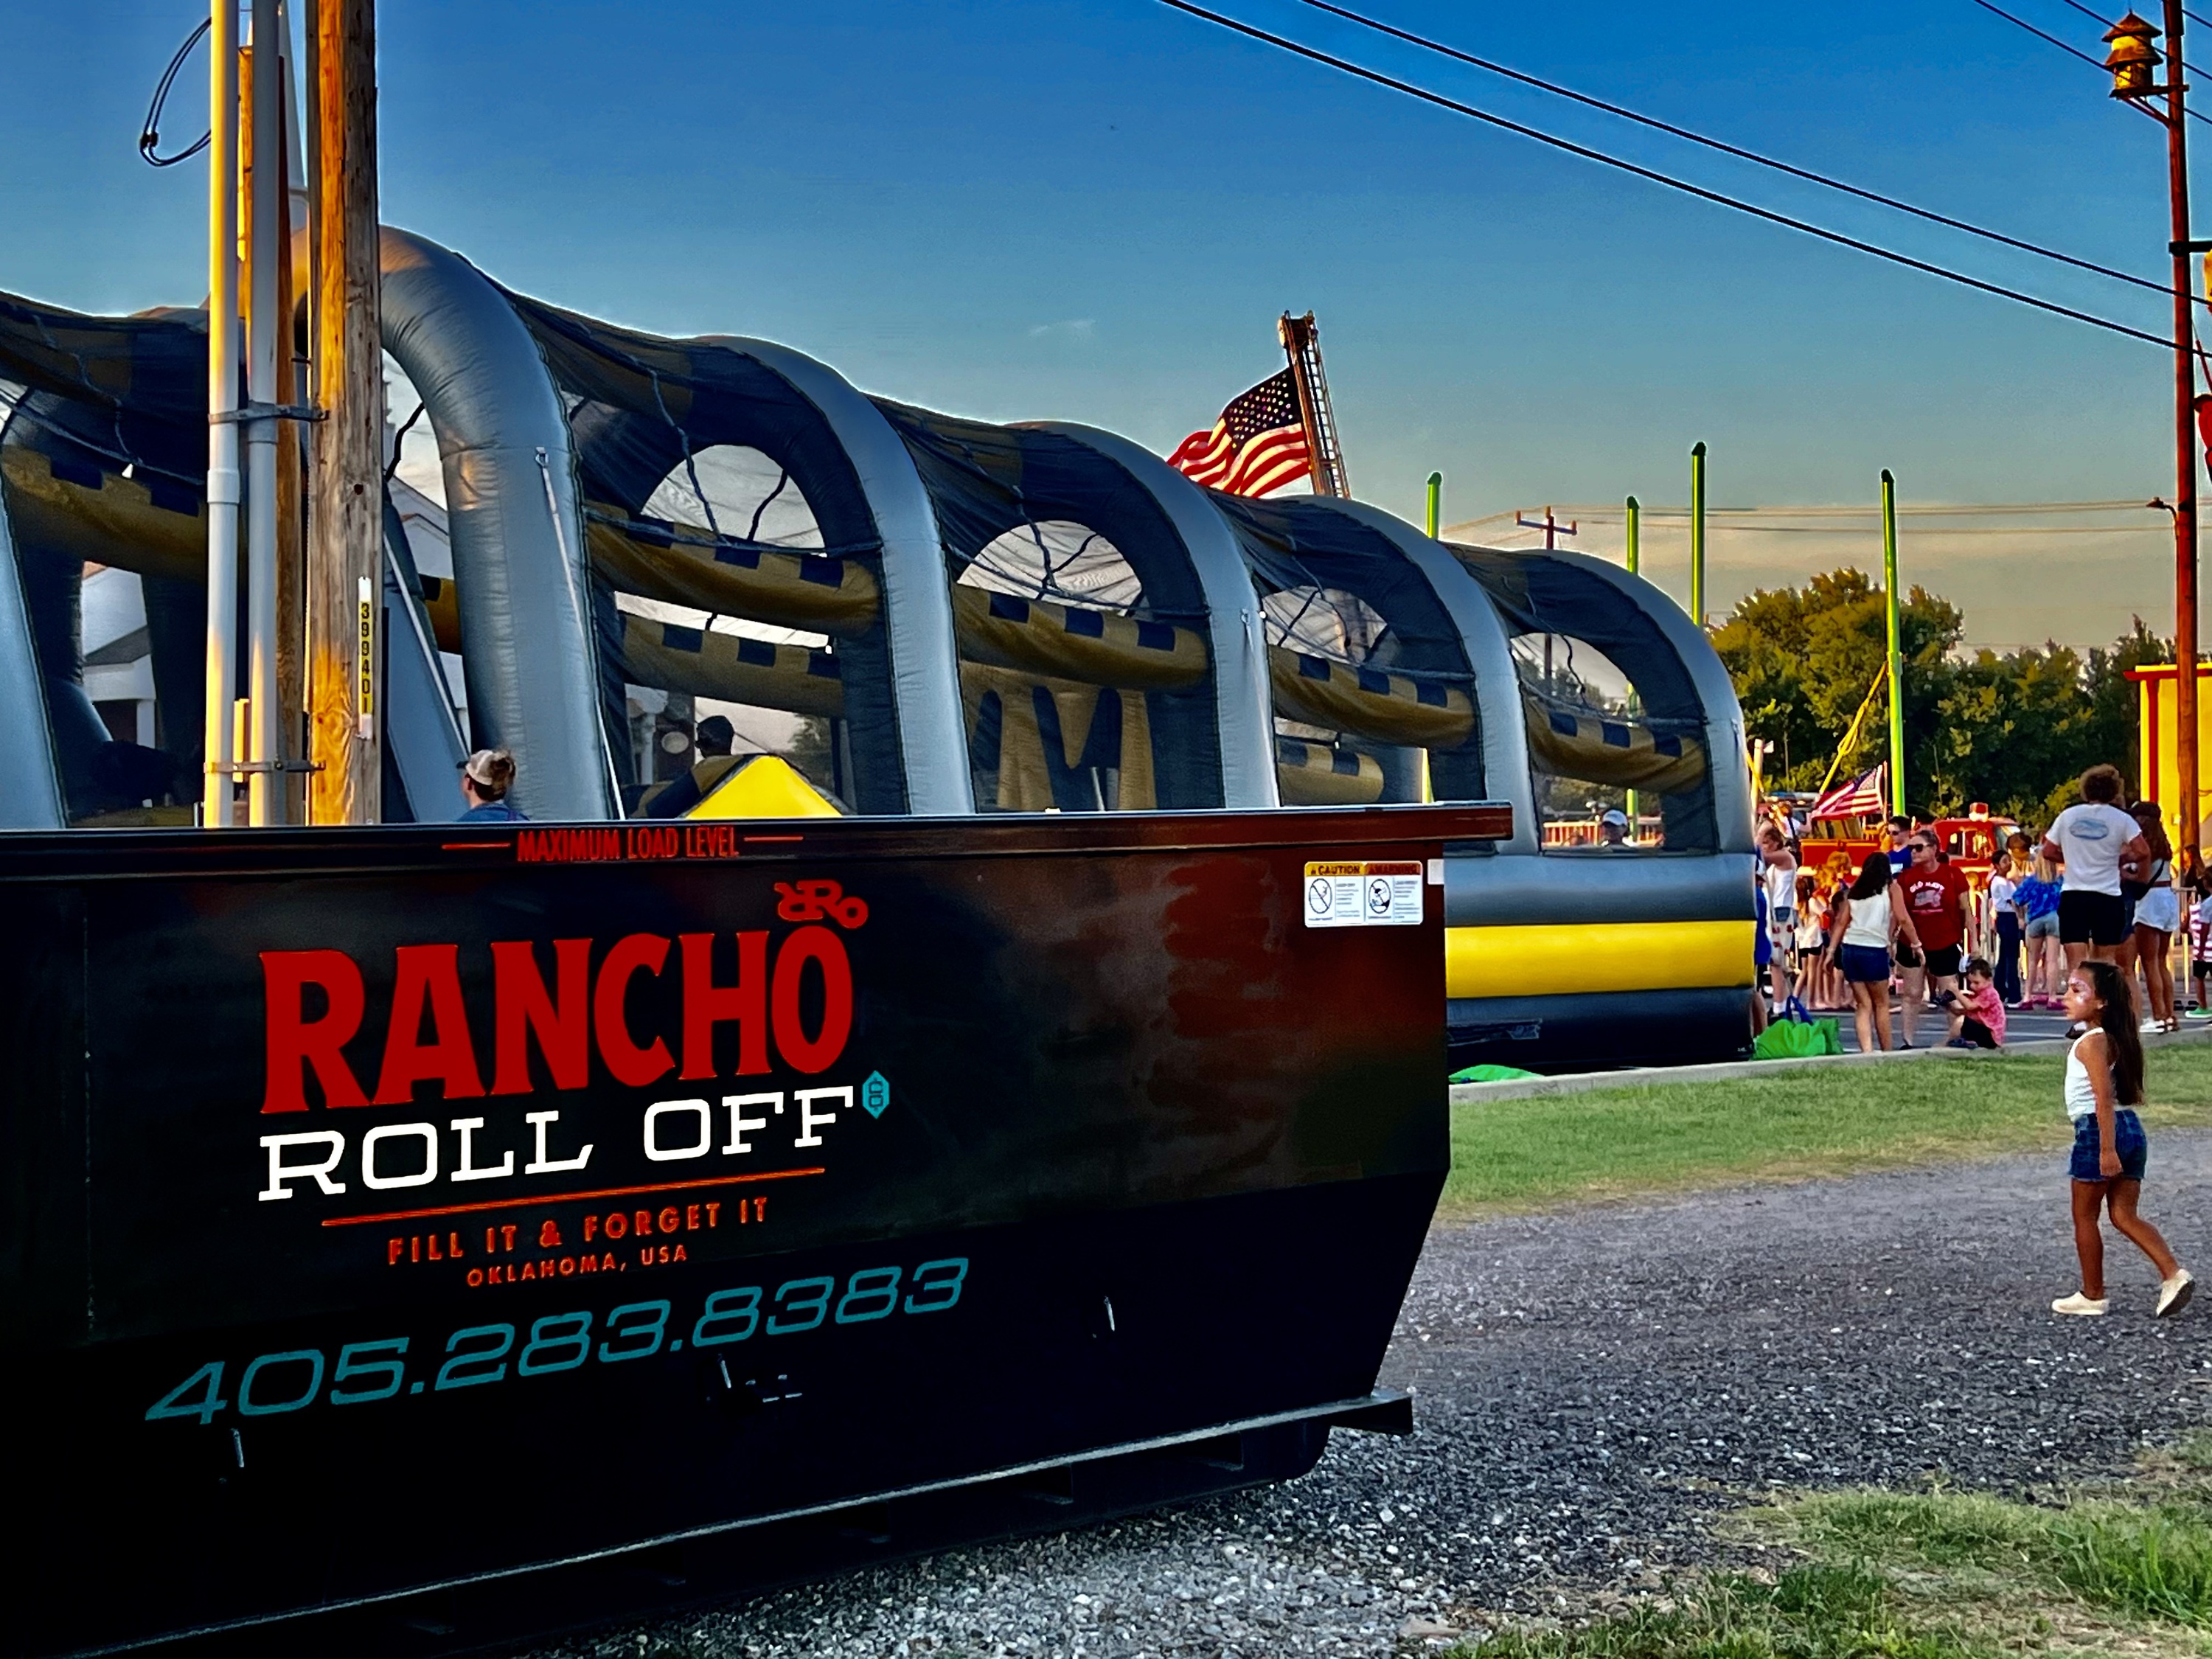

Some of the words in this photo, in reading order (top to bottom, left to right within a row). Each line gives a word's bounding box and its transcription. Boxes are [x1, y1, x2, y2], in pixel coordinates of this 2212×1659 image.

[518, 830, 620, 861] MAXIMUM
[627, 827, 678, 859] LOAD
[686, 827, 740, 858] LEVEL
[1318, 864, 1360, 875] CAUTION
[259, 925, 854, 1113] RANCHO
[259, 1110, 593, 1201] ROLL
[644, 1086, 853, 1162] OFF
[389, 1233, 463, 1265] FILL
[487, 1225, 516, 1253] IT
[540, 1220, 562, 1247] &
[585, 1203, 720, 1242] FORGET
[740, 1197, 767, 1223] IT
[467, 1253, 627, 1287] OKLAHOMA,
[641, 1245, 686, 1265] USA
[145, 1257, 969, 1425] 405.283.8383
